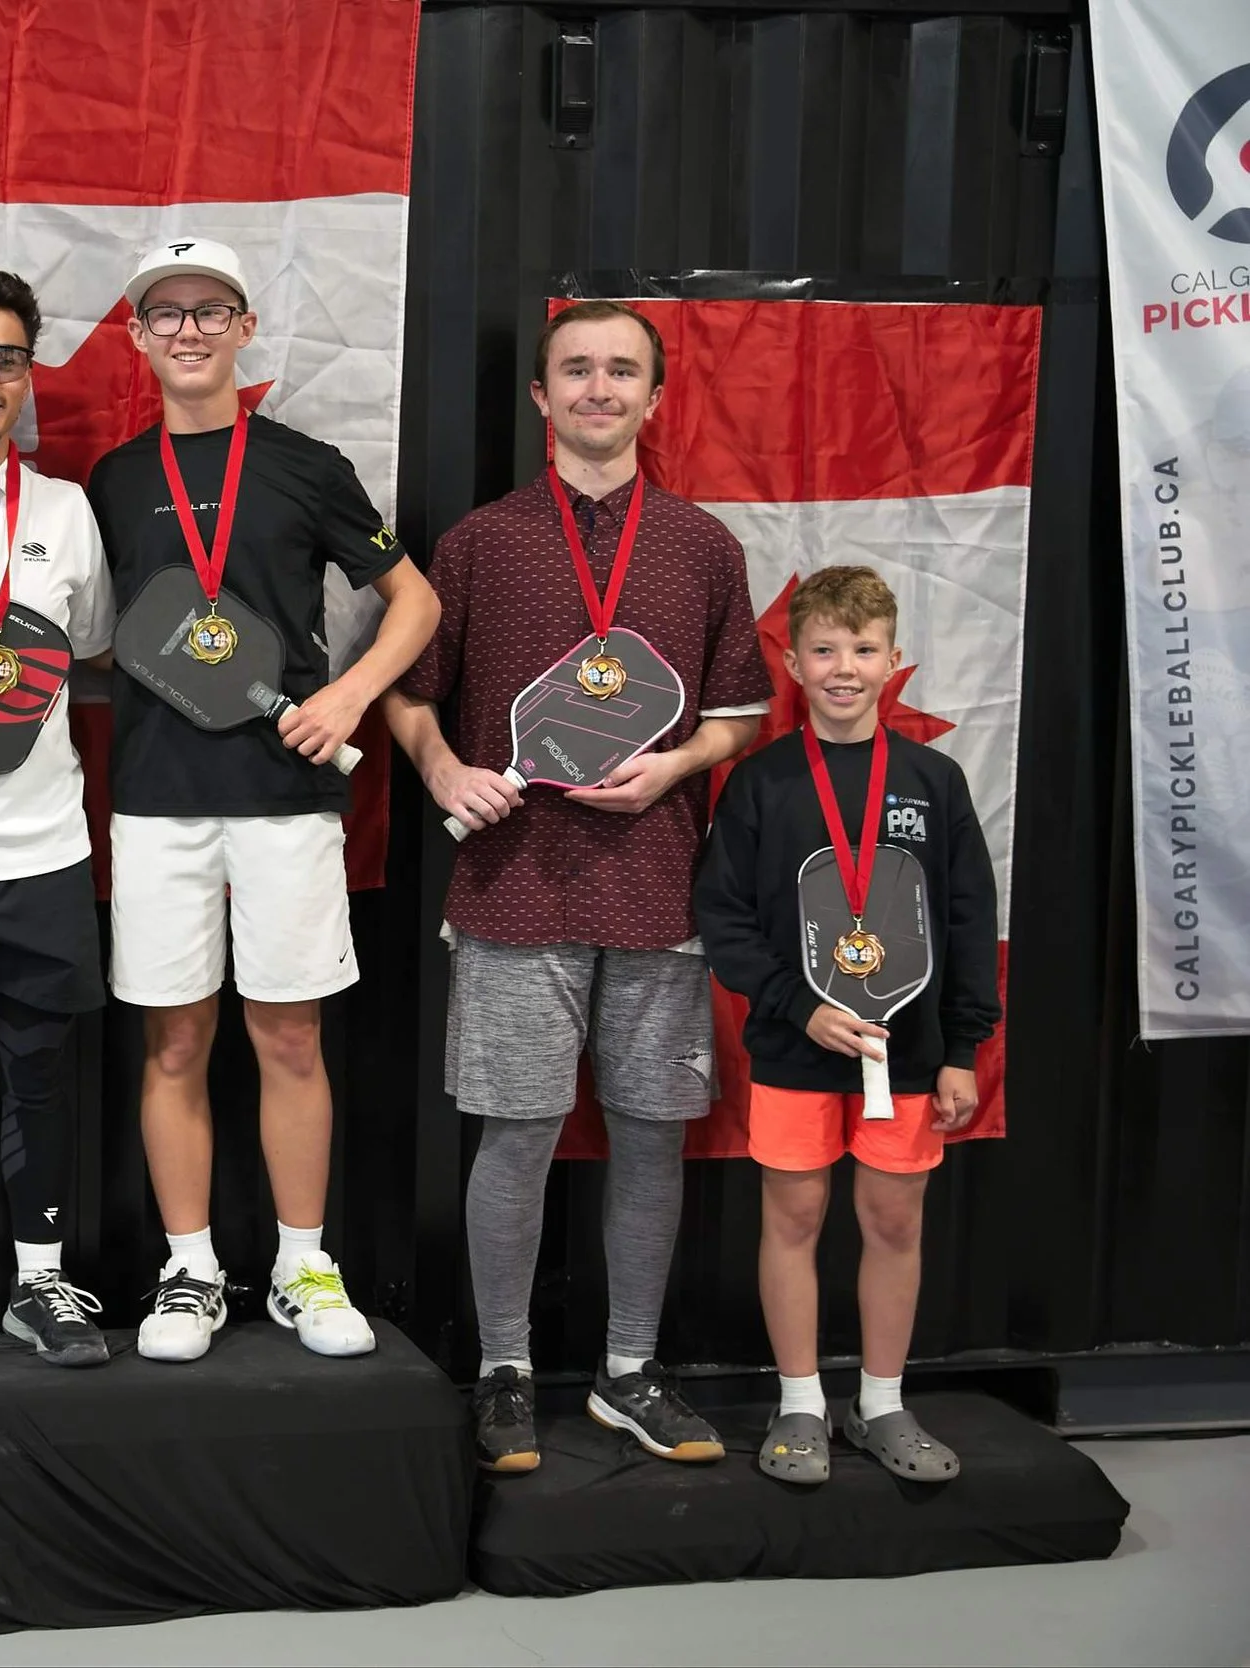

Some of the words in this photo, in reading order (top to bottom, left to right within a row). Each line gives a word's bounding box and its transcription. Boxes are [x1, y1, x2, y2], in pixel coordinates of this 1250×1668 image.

[8, 613, 46, 636] SELKIRK
[130, 658, 211, 723] PADDLETEK
[1153, 456, 1200, 1001] CALGARYPICKLEBALLCLUB.CA
[541, 736, 585, 782] POACH
[898, 797, 930, 807] CARVANA
[887, 807, 926, 836] PPA
